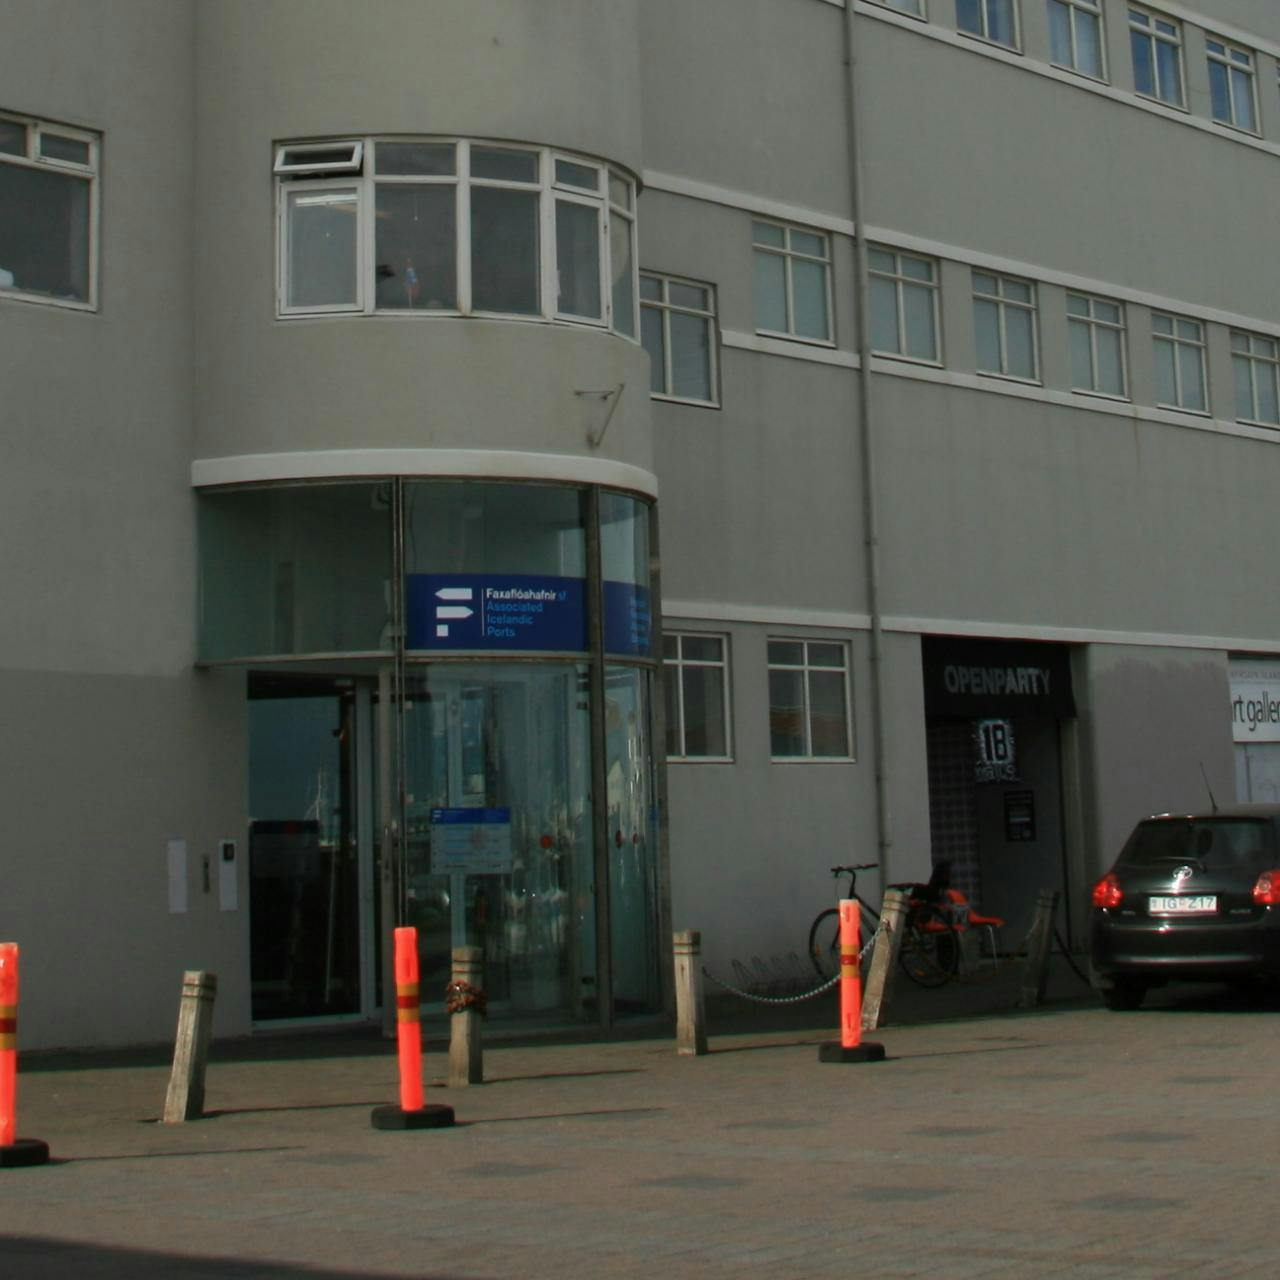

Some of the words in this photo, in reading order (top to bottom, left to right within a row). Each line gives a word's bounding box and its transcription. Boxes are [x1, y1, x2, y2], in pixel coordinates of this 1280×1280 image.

[487, 601, 544, 612] Associated
[487, 614, 534, 625] Icelandic
[487, 626, 516, 637] Ports
[1231, 695, 1245, 723] rt
